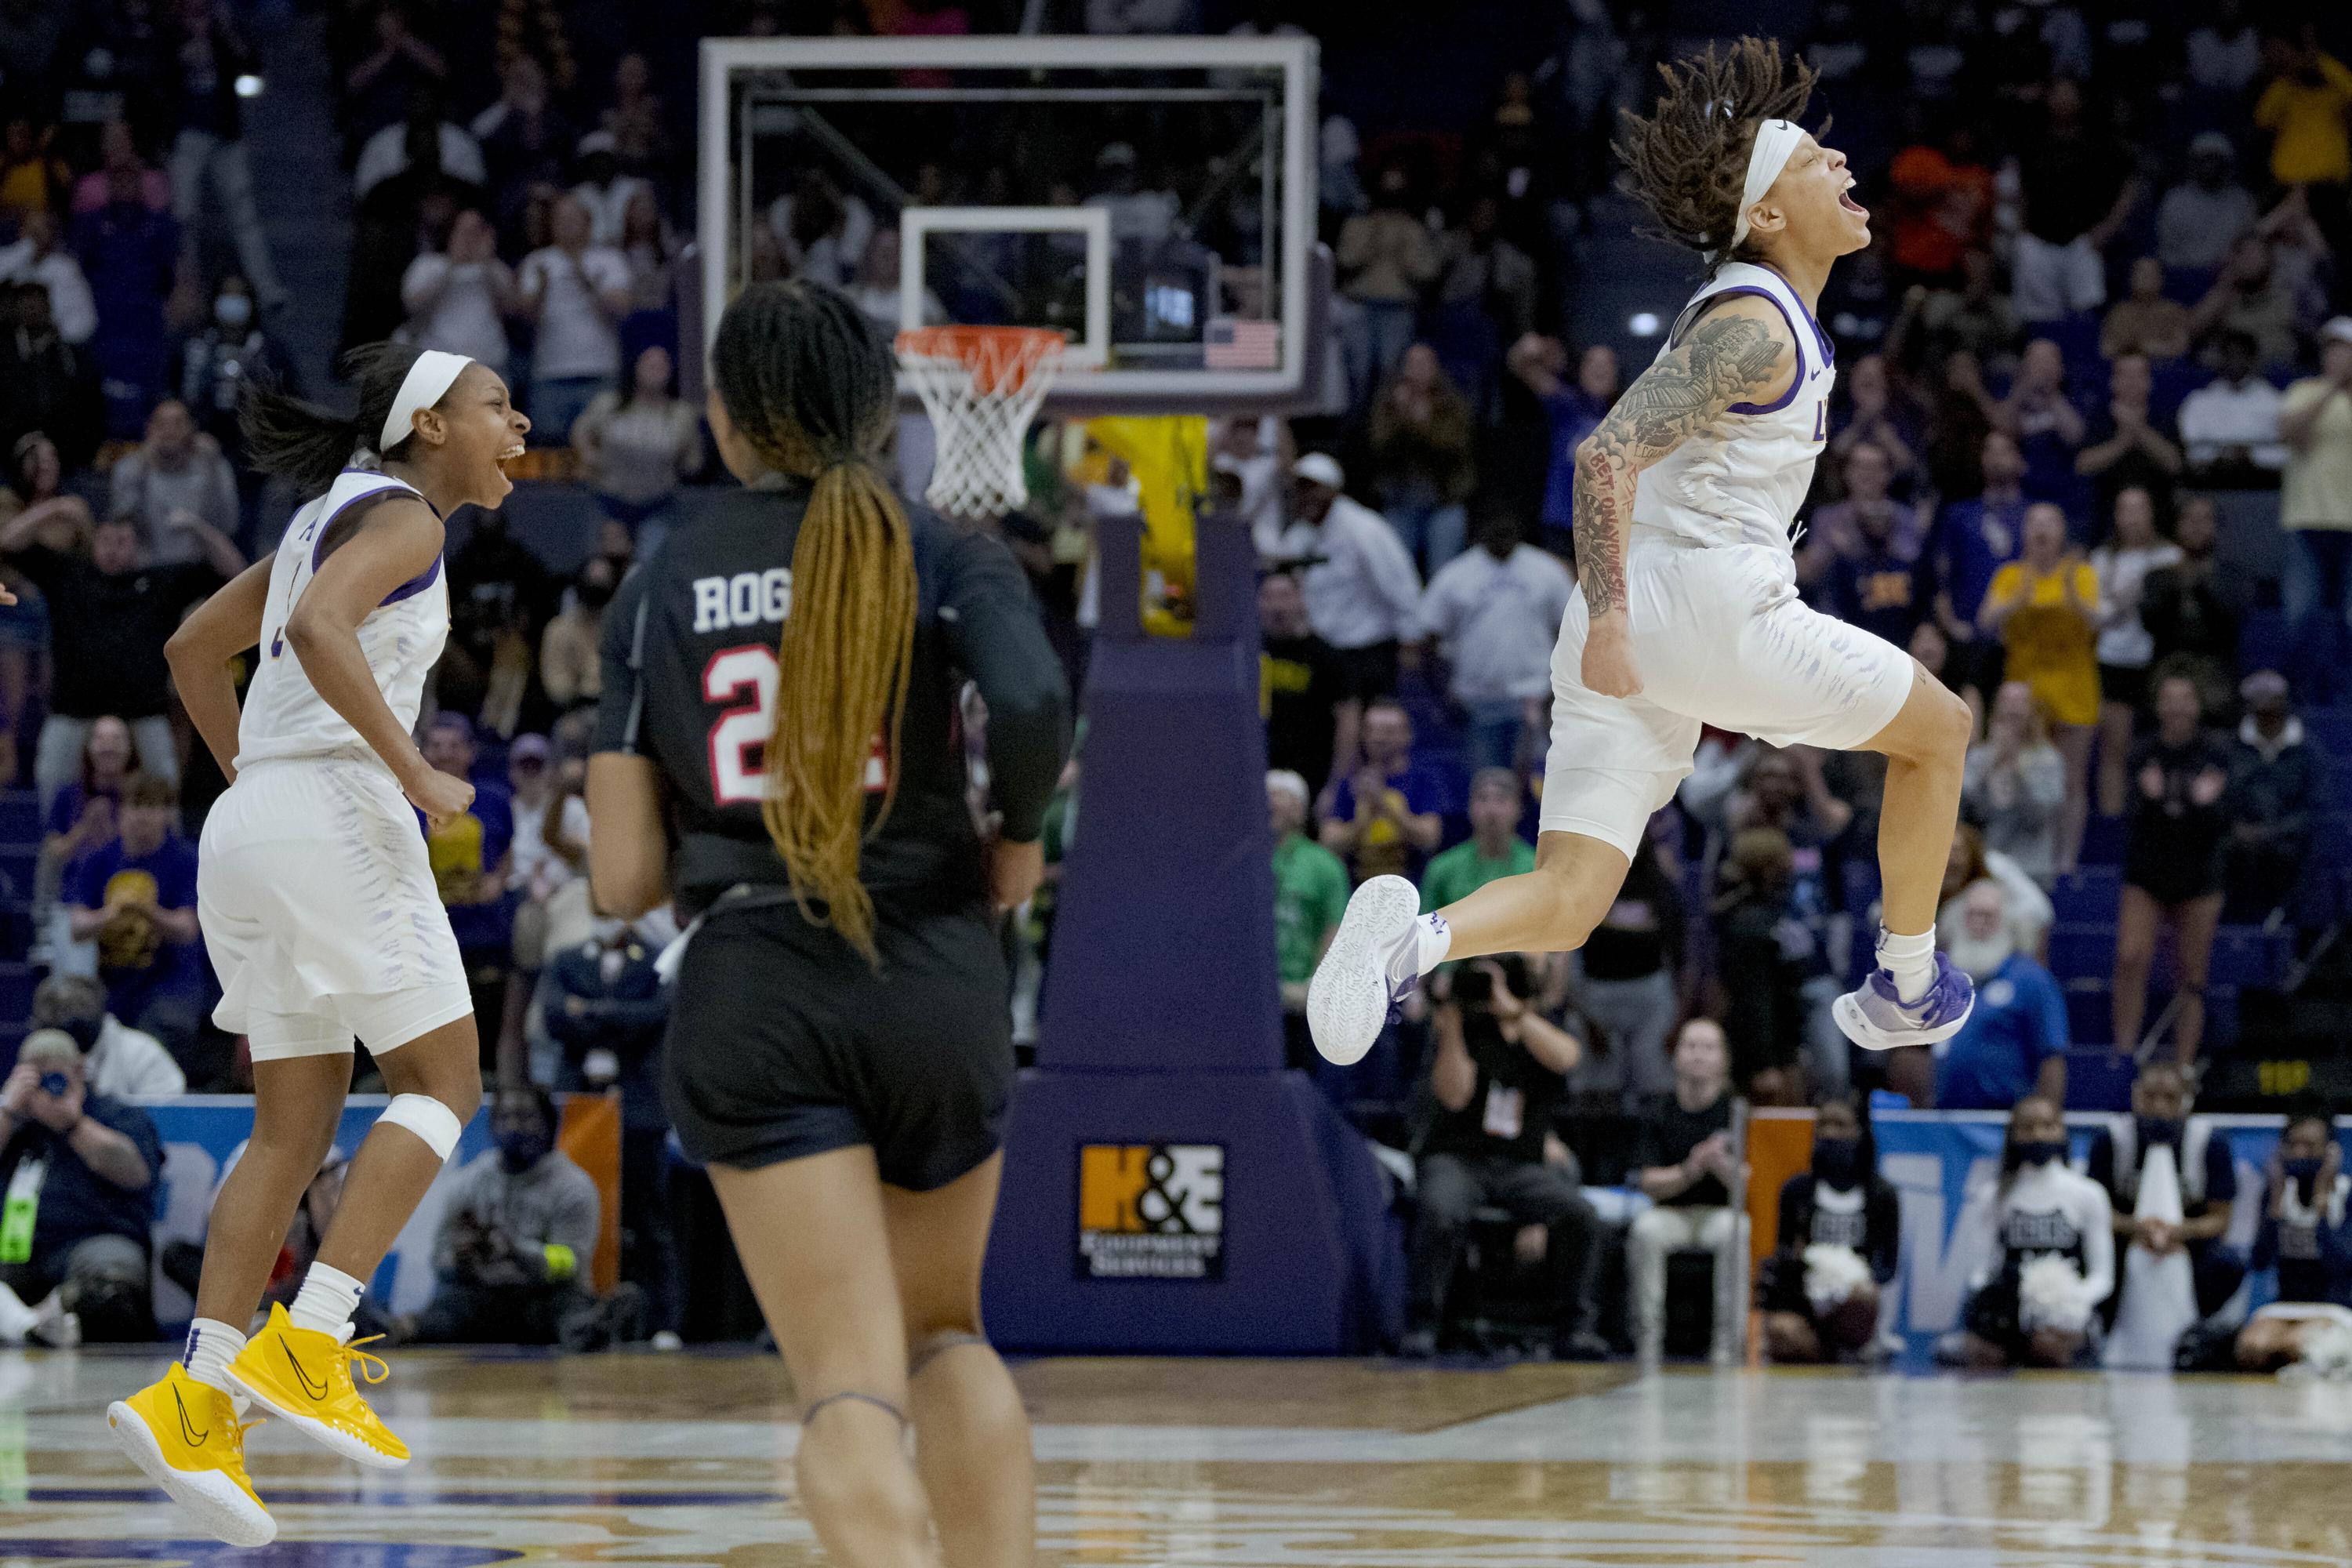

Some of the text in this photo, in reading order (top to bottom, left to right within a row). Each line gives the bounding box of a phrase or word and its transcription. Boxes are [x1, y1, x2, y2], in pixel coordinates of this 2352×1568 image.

[1590, 452, 1614, 489] BET
[1601, 497, 1619, 524] ON
[693, 568, 793, 633] ROG
[1080, 1145, 1224, 1233] H&E
